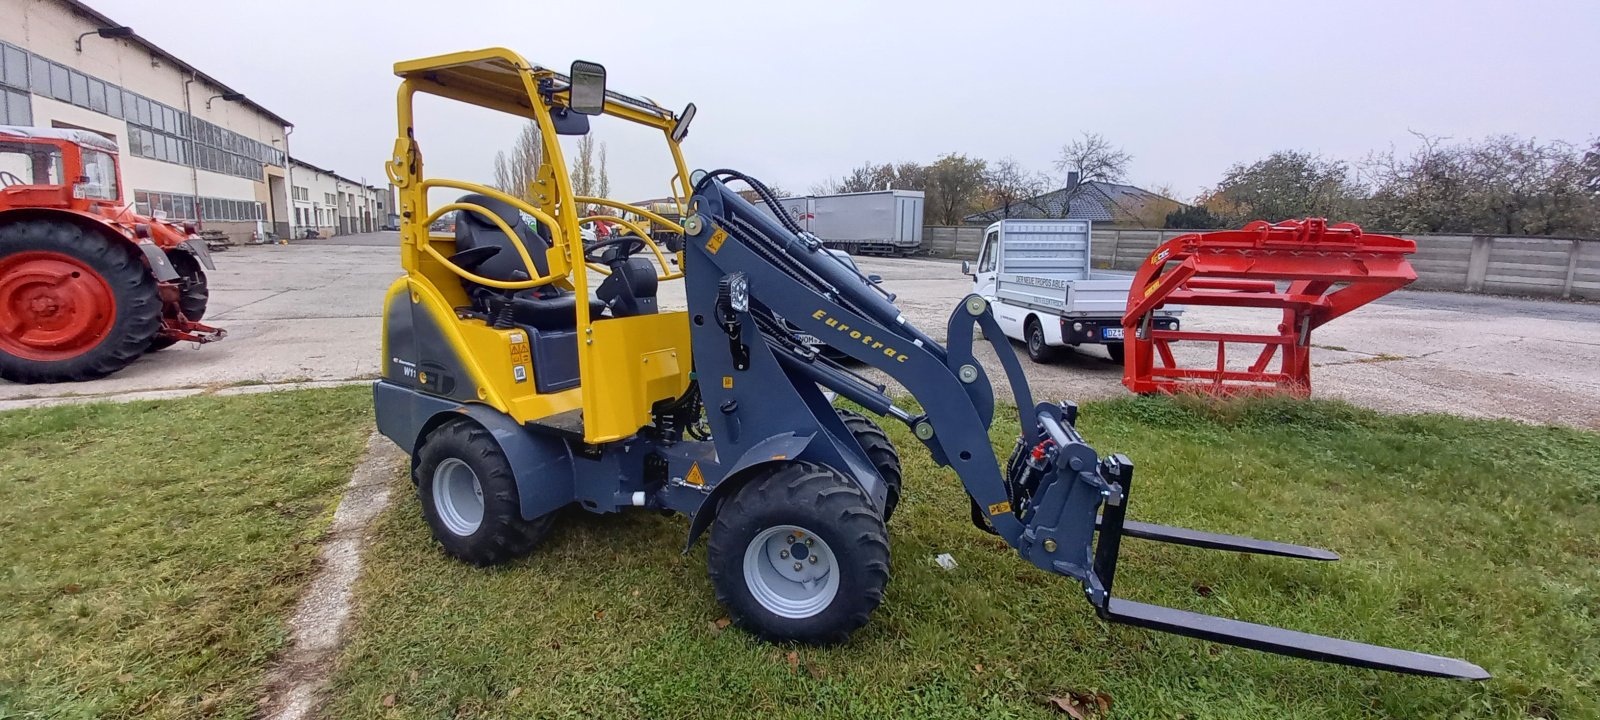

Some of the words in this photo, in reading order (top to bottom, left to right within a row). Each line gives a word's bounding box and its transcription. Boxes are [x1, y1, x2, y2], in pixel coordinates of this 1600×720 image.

[812, 310, 909, 362] Eurotrac
[1107, 329, 1117, 337] DZ
[403, 366, 416, 378] W11
